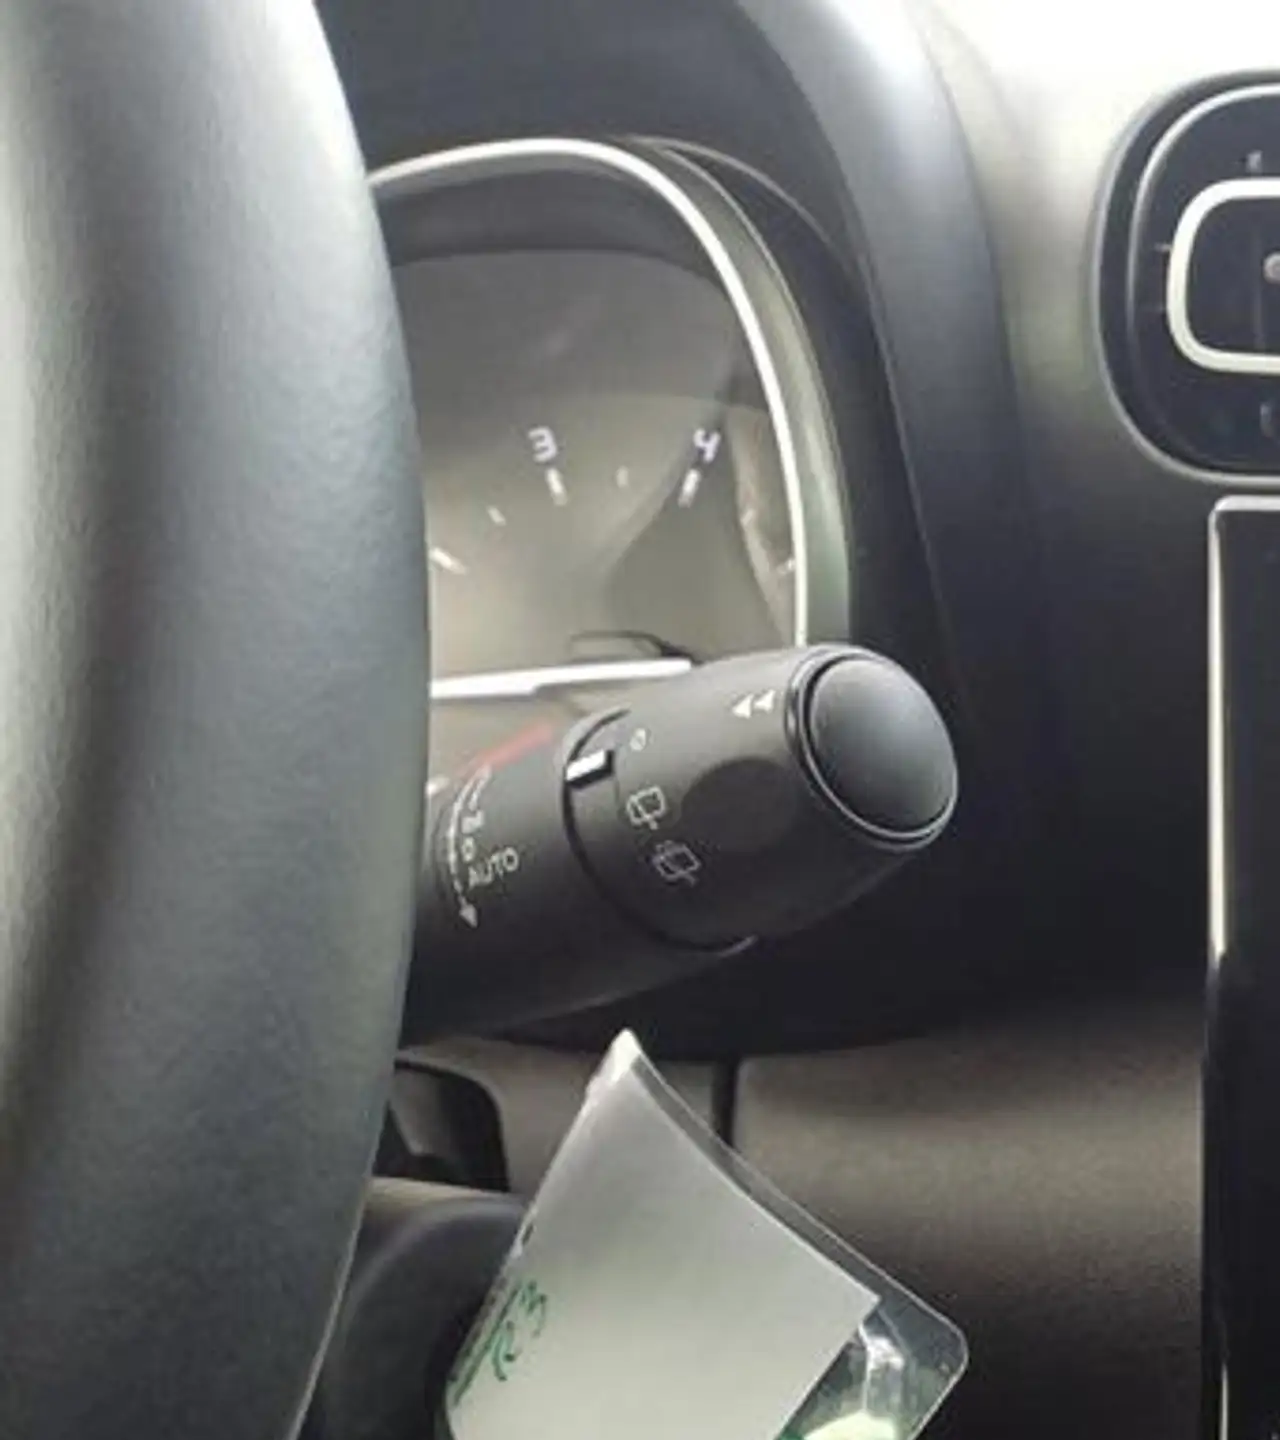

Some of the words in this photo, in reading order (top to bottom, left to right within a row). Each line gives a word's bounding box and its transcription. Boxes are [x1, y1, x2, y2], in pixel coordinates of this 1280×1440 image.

[528, 427, 558, 462] 3
[693, 427, 721, 463] 4
[467, 847, 519, 891] AUTO
